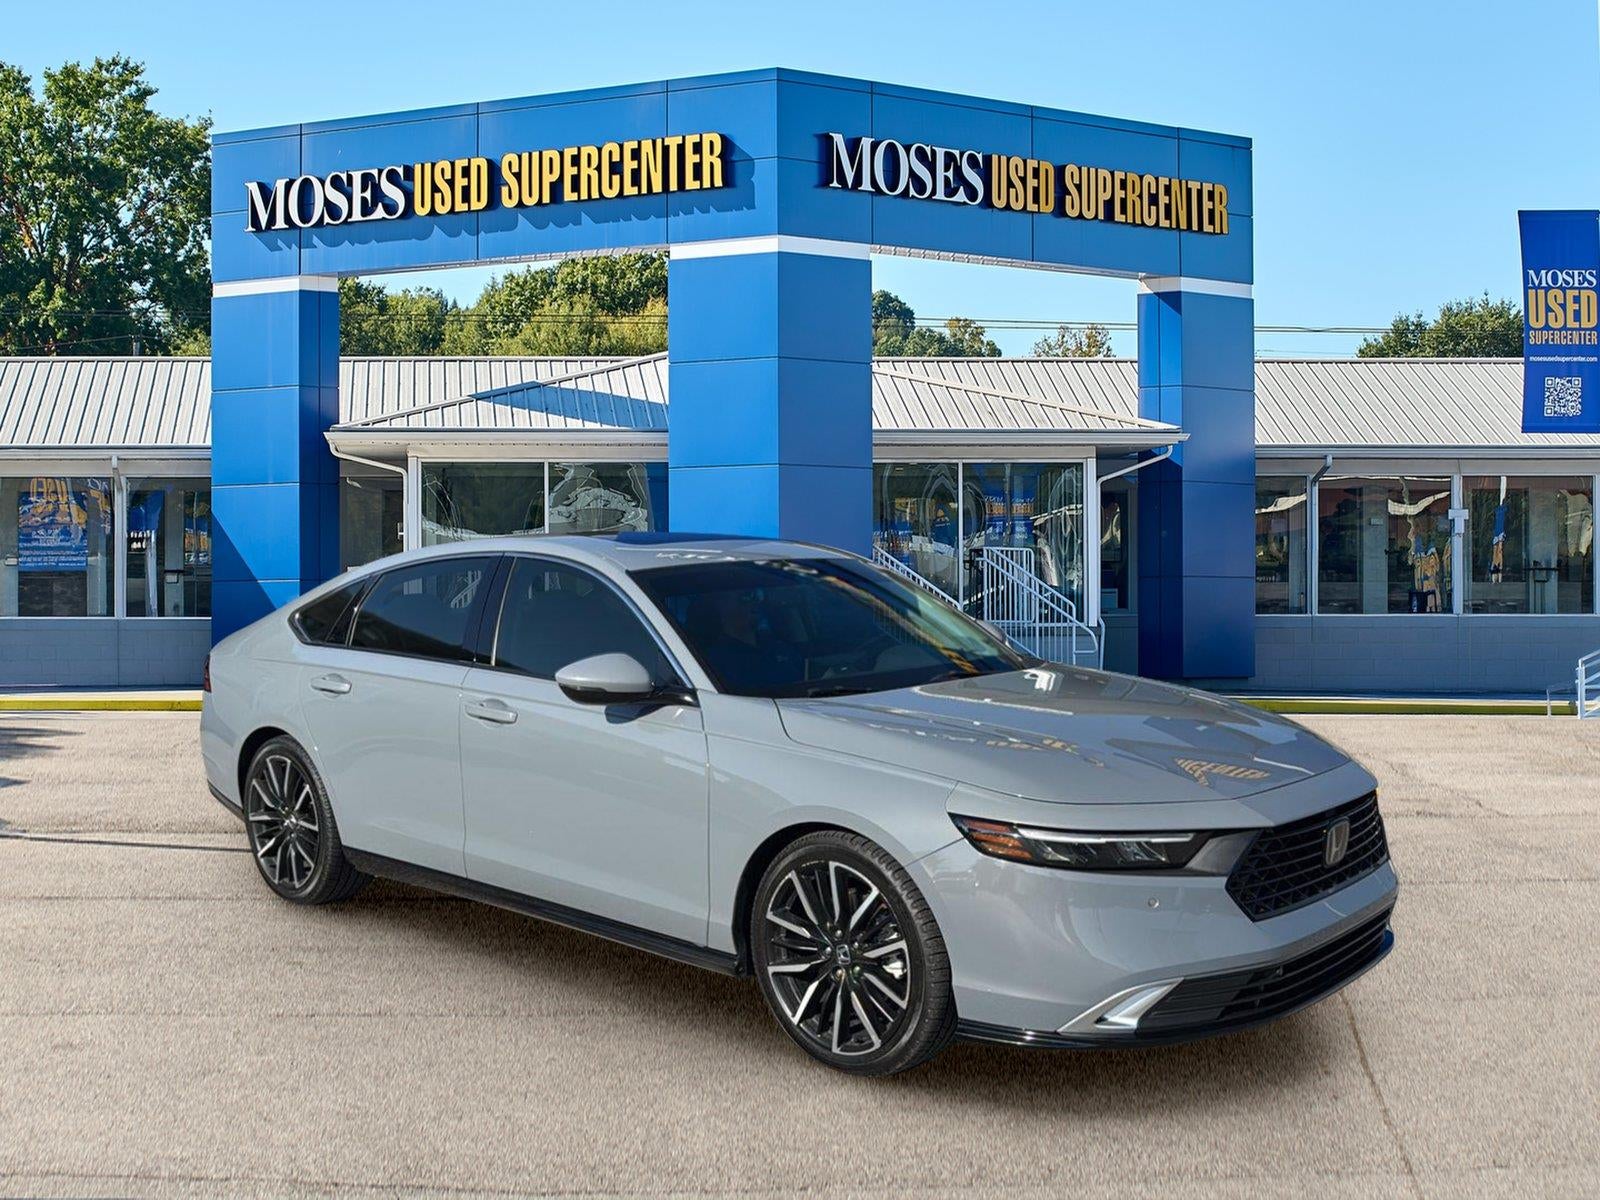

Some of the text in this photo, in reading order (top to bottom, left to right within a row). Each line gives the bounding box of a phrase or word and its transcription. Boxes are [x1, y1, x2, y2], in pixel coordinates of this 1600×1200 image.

[244, 132, 723, 232] MOSES USED SUPERCENTER
[829, 133, 1229, 235] MOSES USED SUPERCENTER
[1527, 269, 1597, 287] MOSES
[1528, 289, 1597, 328] USED
[1529, 330, 1597, 345] SUPERCENTER
